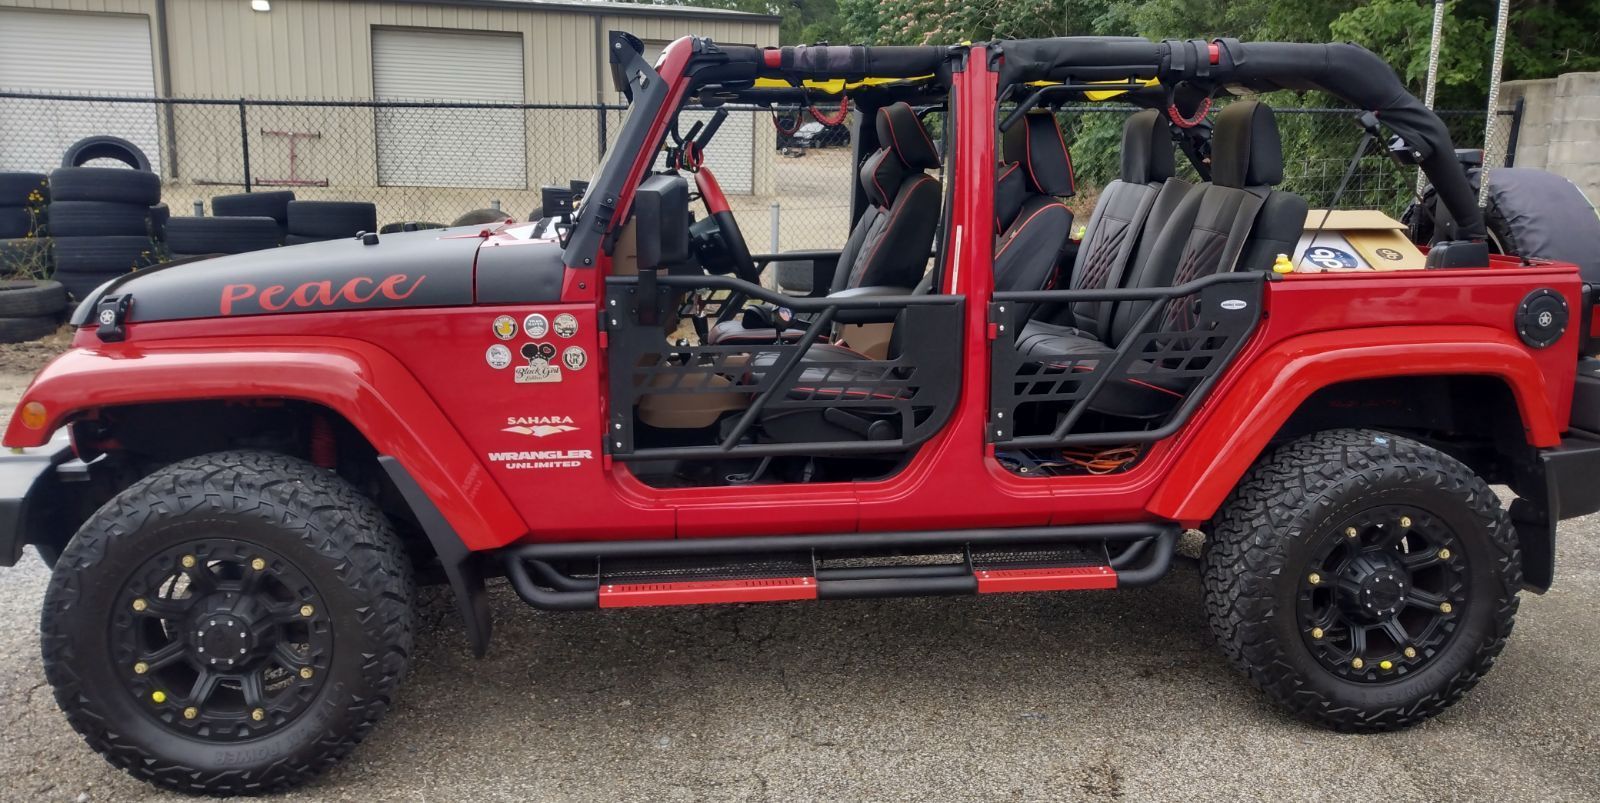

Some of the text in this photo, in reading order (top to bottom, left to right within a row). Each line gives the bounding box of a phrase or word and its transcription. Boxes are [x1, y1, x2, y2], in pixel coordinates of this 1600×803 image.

[220, 274, 426, 315] Peace
[507, 416, 574, 425] SAHARA
[488, 450, 593, 461] WRANGLER
[506, 461, 581, 470] UNLIMITED
